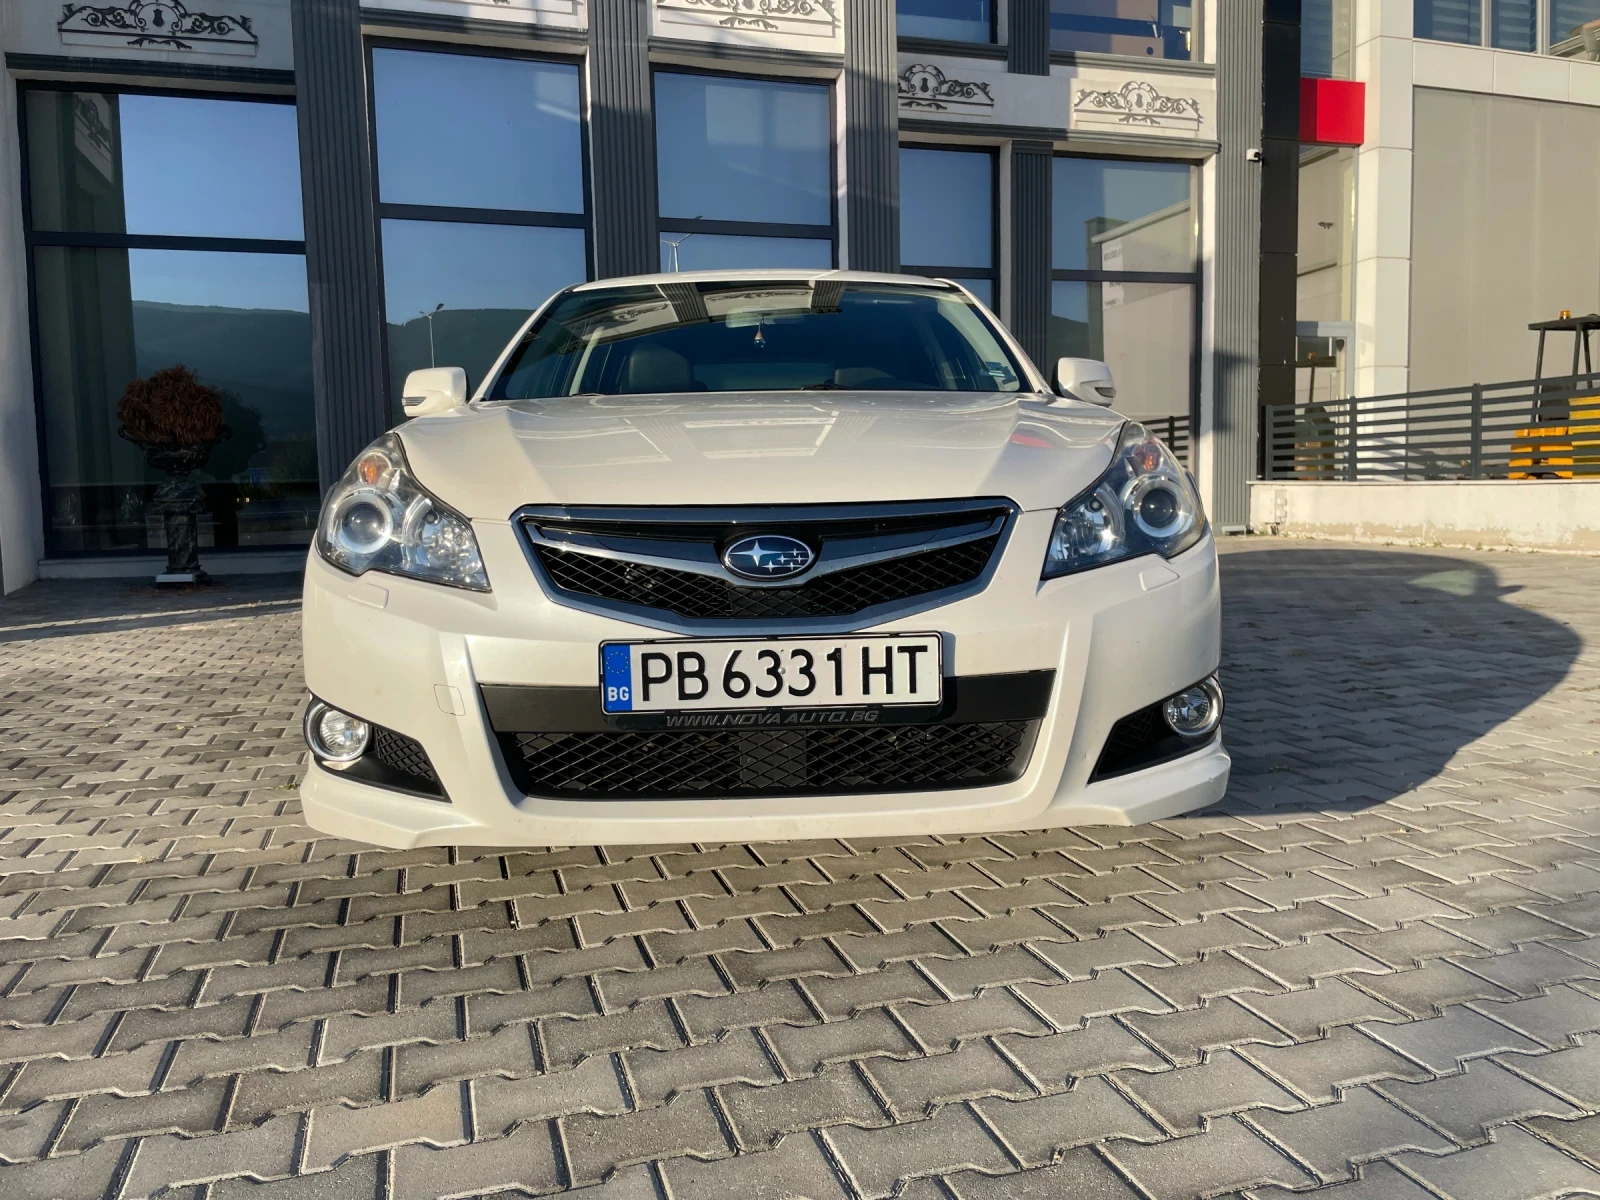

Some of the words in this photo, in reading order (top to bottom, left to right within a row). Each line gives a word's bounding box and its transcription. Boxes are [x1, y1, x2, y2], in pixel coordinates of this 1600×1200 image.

[641, 651, 709, 702] PB
[722, 647, 843, 699] 6331
[862, 645, 928, 696] HT
[607, 686, 630, 702] BG
